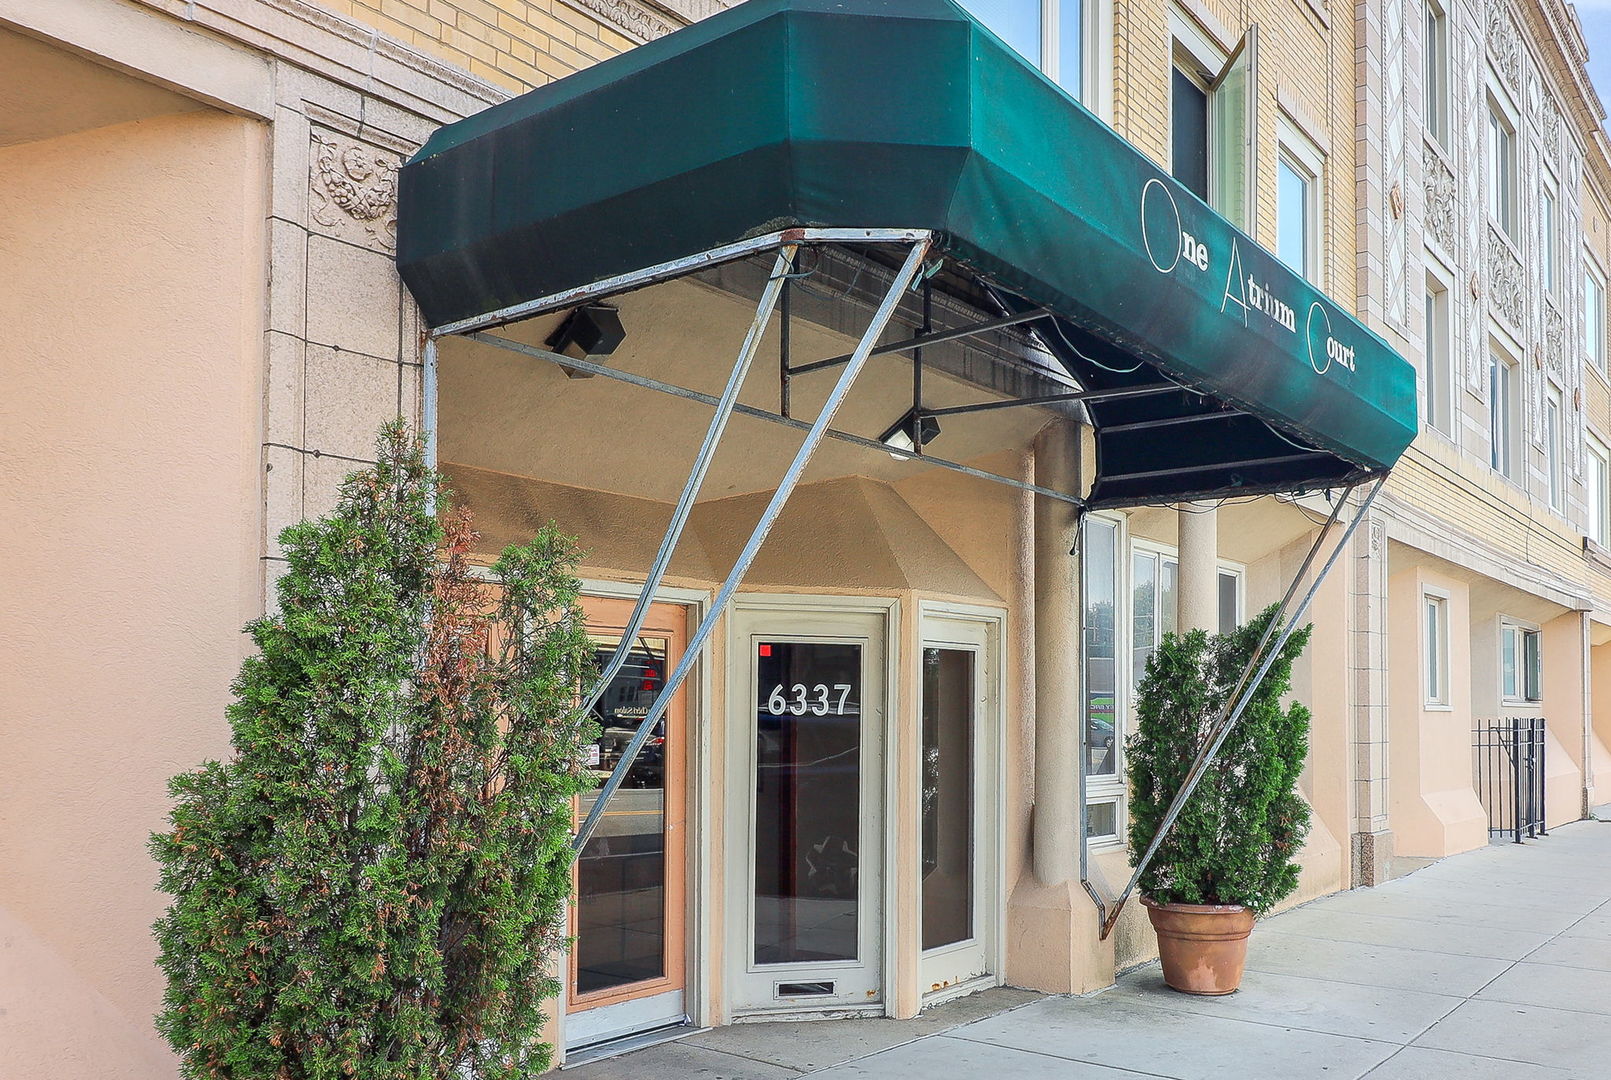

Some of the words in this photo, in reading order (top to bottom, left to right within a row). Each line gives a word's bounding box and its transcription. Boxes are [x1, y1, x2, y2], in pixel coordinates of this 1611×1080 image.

[1141, 178, 1209, 273] One
[1220, 236, 1297, 334] Atrium
[1306, 301, 1356, 375] Court
[767, 683, 852, 717] 6337
